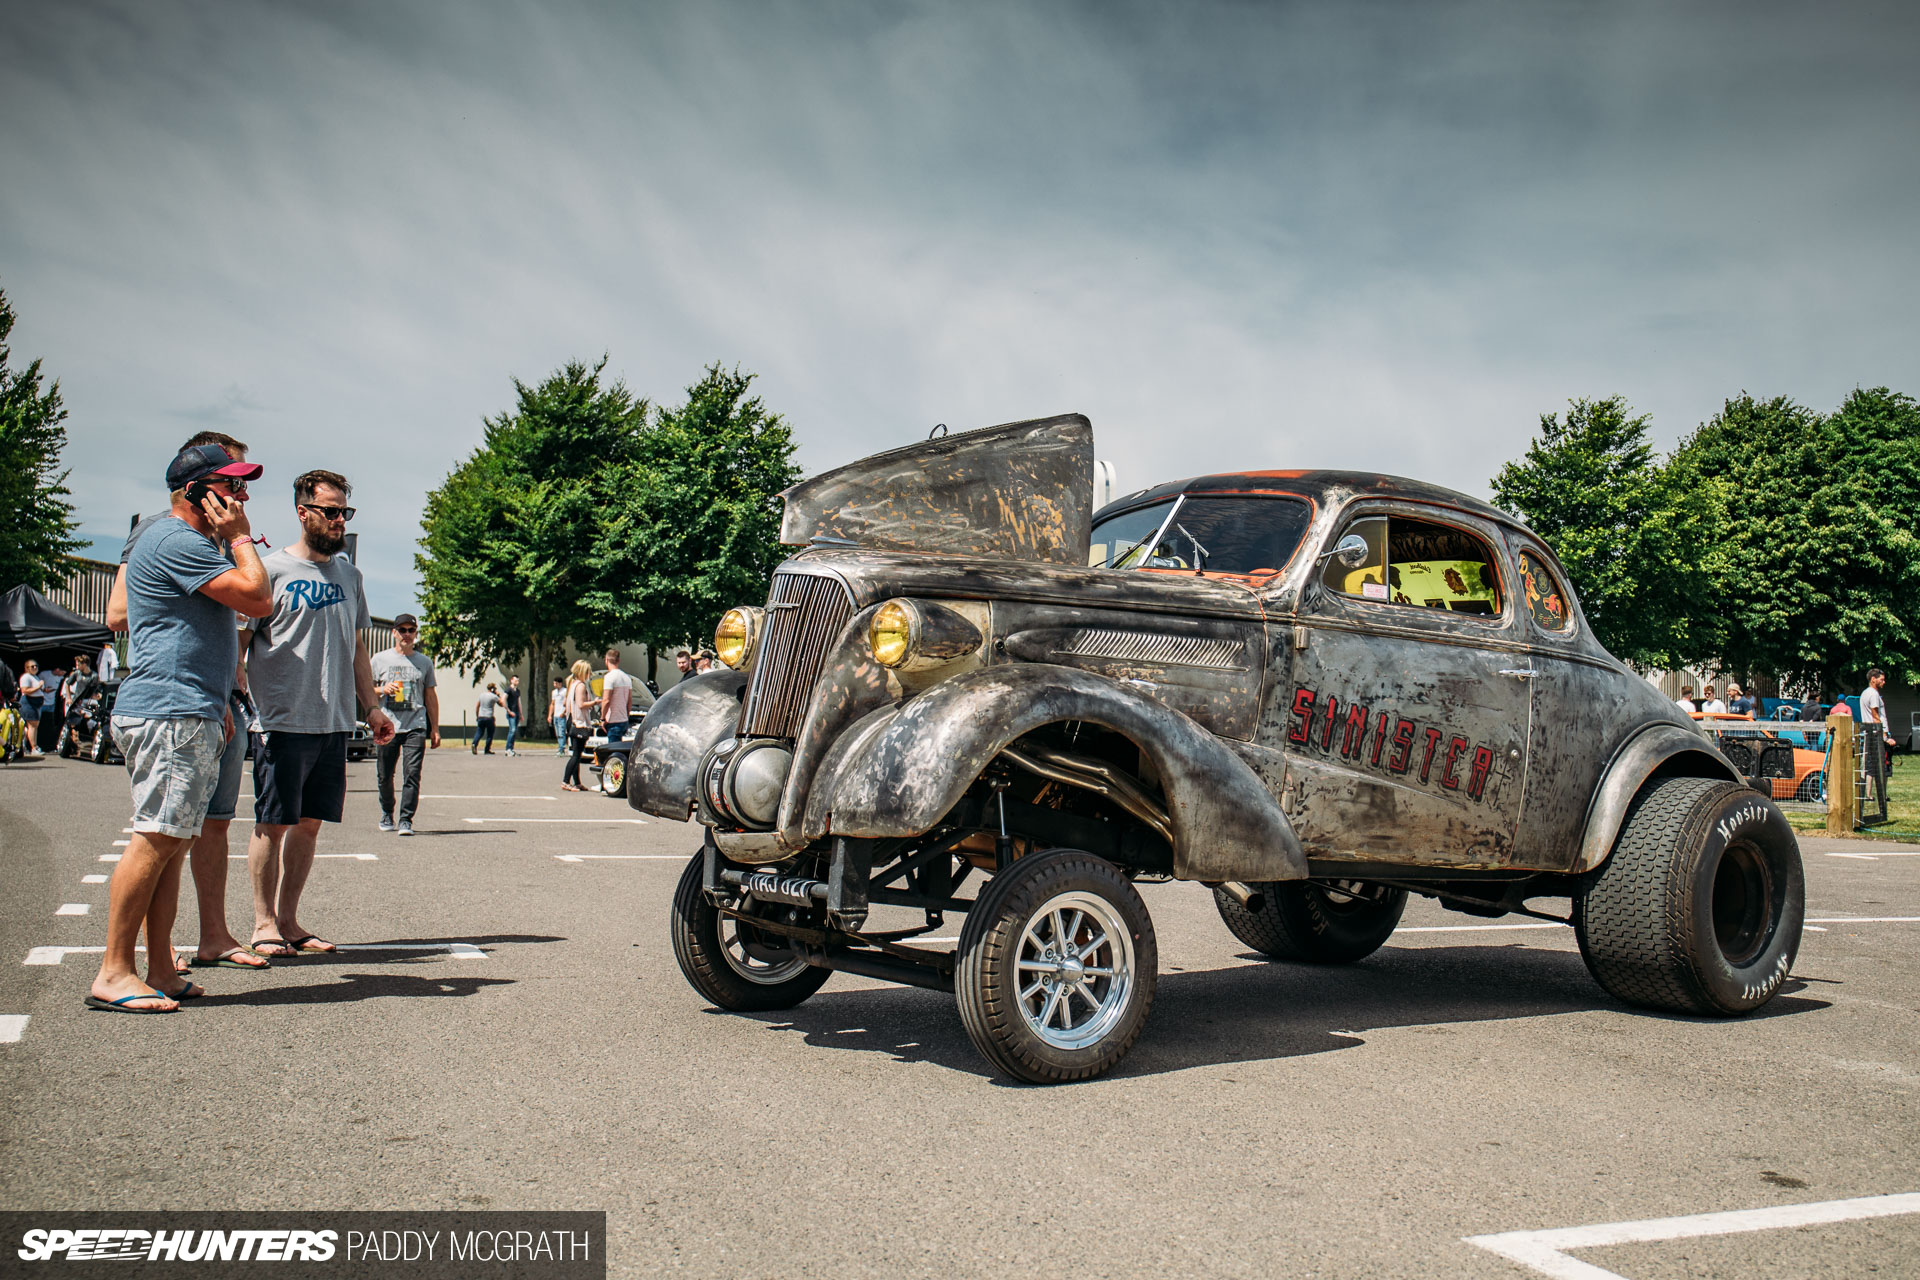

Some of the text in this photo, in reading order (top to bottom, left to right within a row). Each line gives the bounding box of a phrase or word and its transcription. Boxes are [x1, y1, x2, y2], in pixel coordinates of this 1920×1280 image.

[1288, 687, 1493, 802] SINISTER
[1716, 800, 1769, 847] Hoosier
[1741, 952, 1788, 1000] Hoosier
